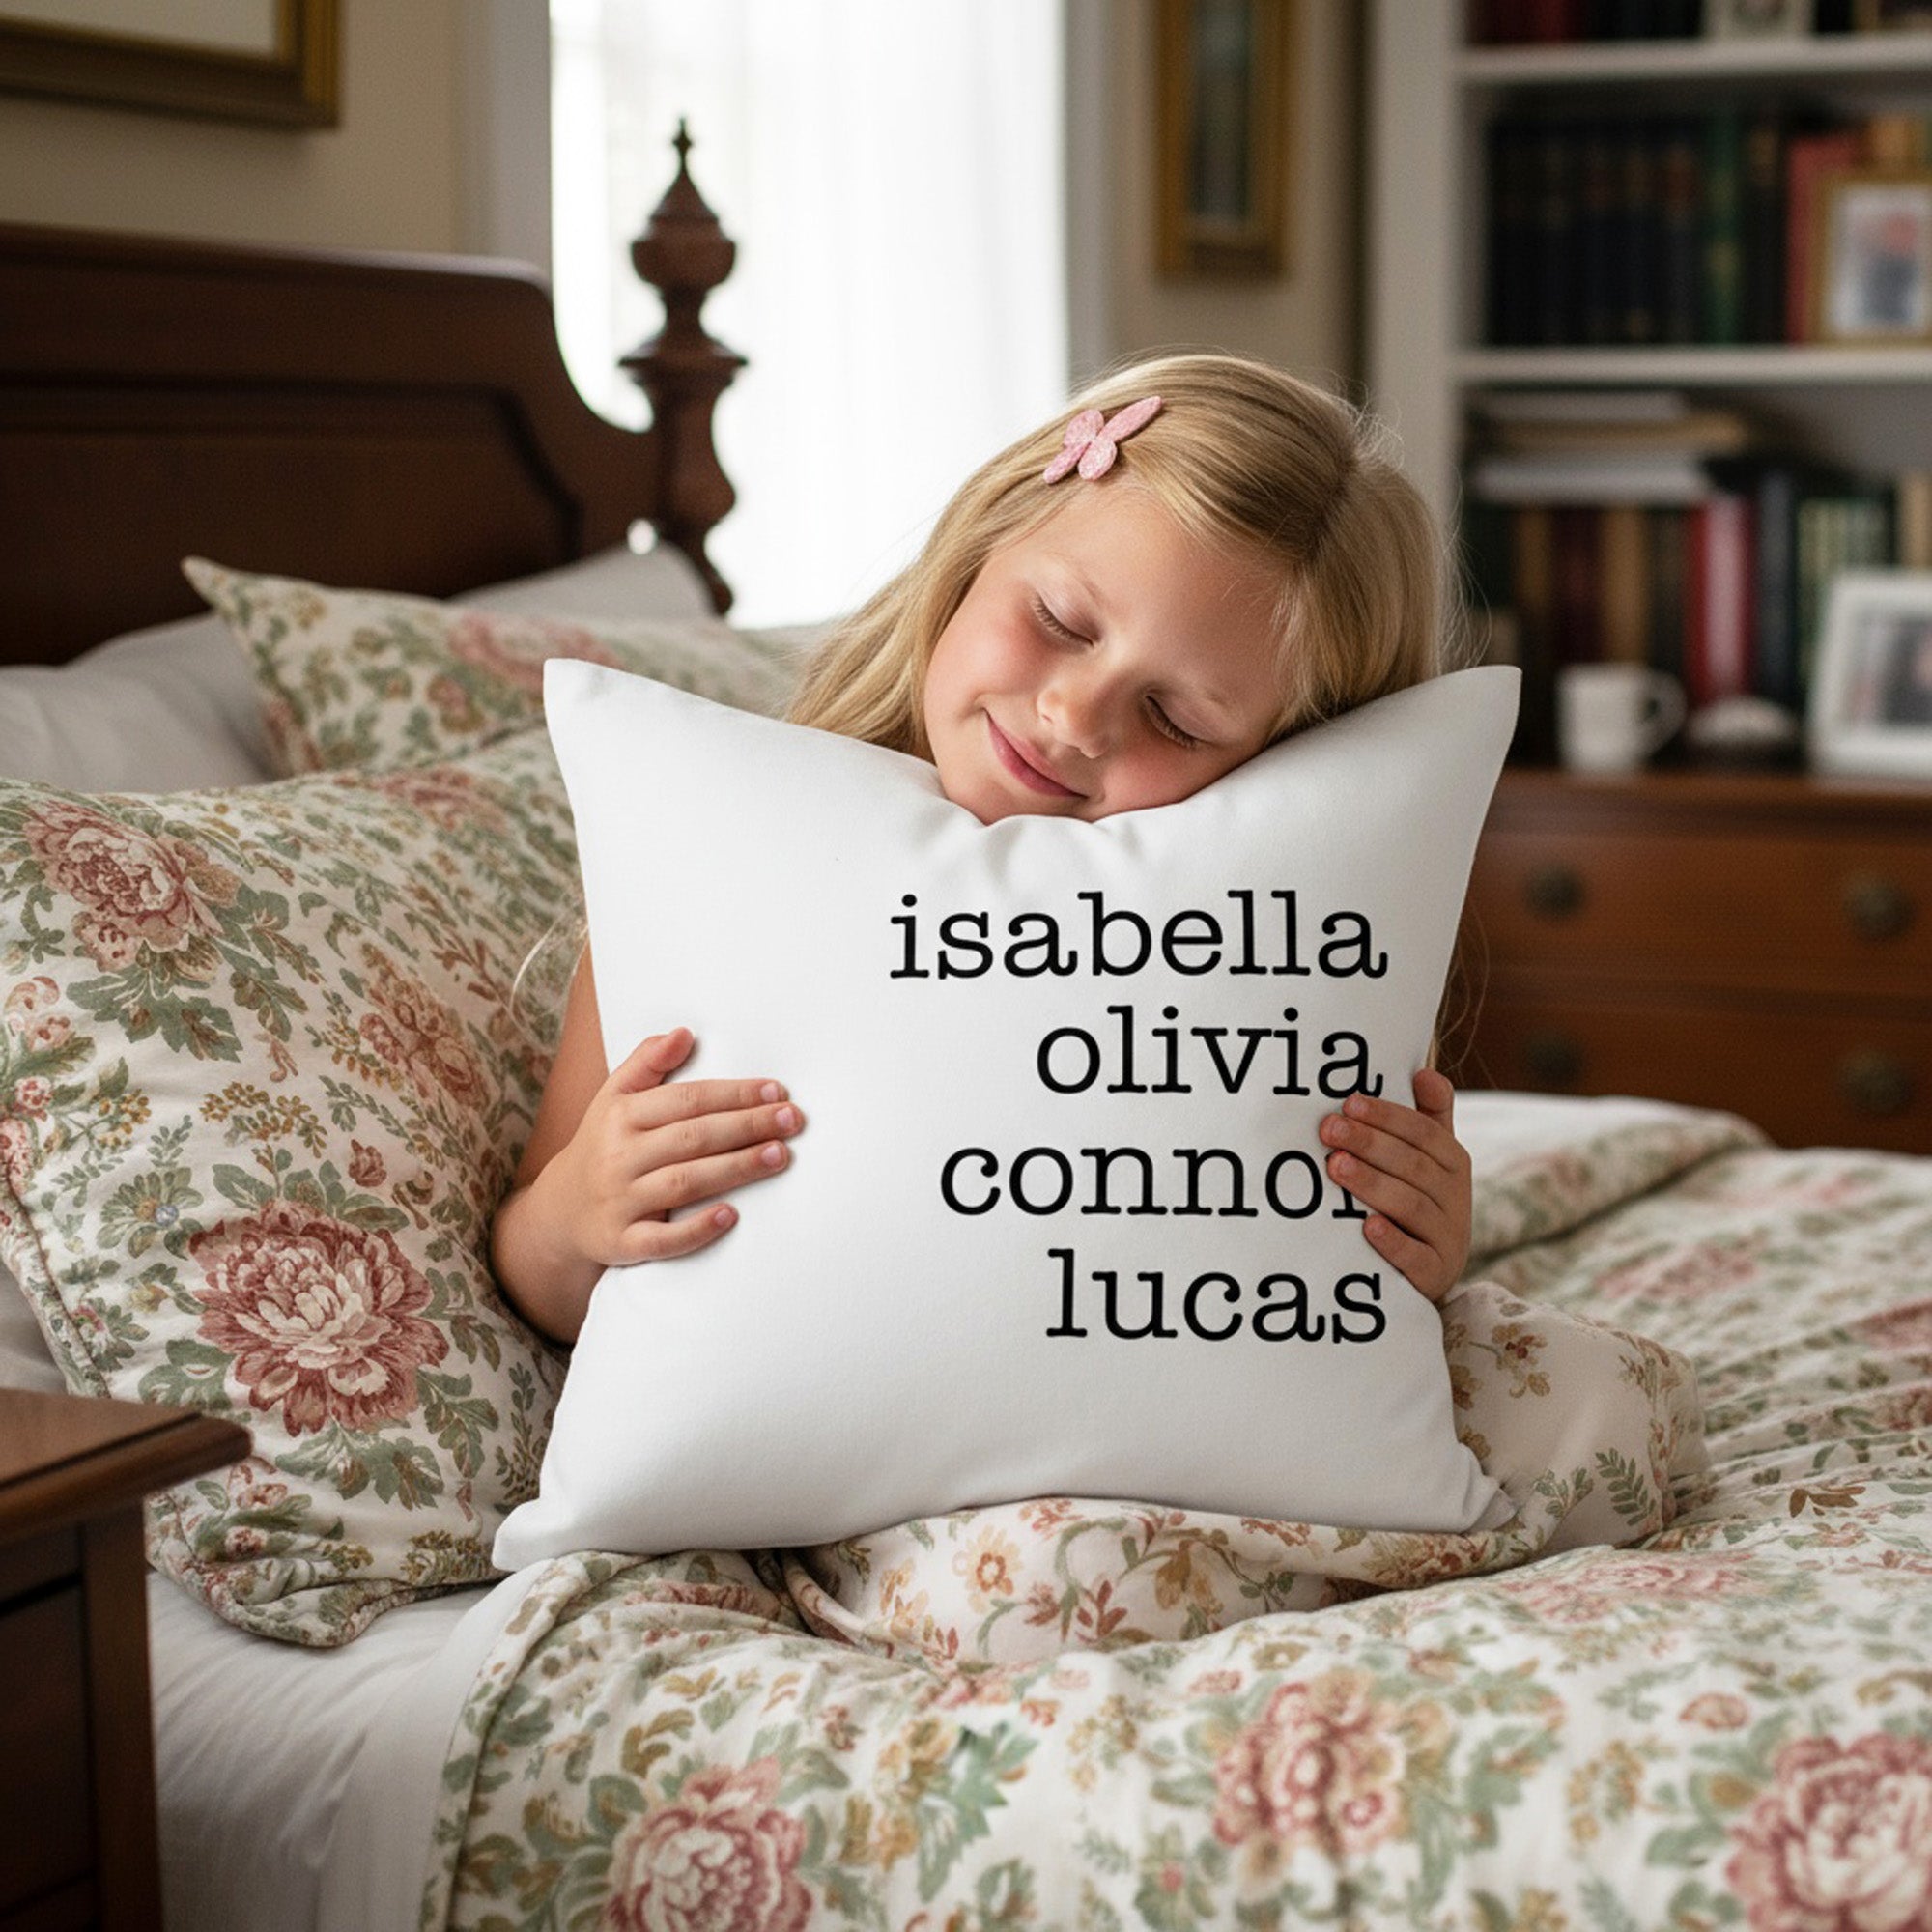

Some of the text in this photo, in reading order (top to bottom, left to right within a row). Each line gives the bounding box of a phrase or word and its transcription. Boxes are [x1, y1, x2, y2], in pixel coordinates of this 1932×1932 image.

[890, 890, 1388, 980] isabella
[1037, 1005, 1384, 1099] olivia
[1046, 1248, 1386, 1344] lucas
